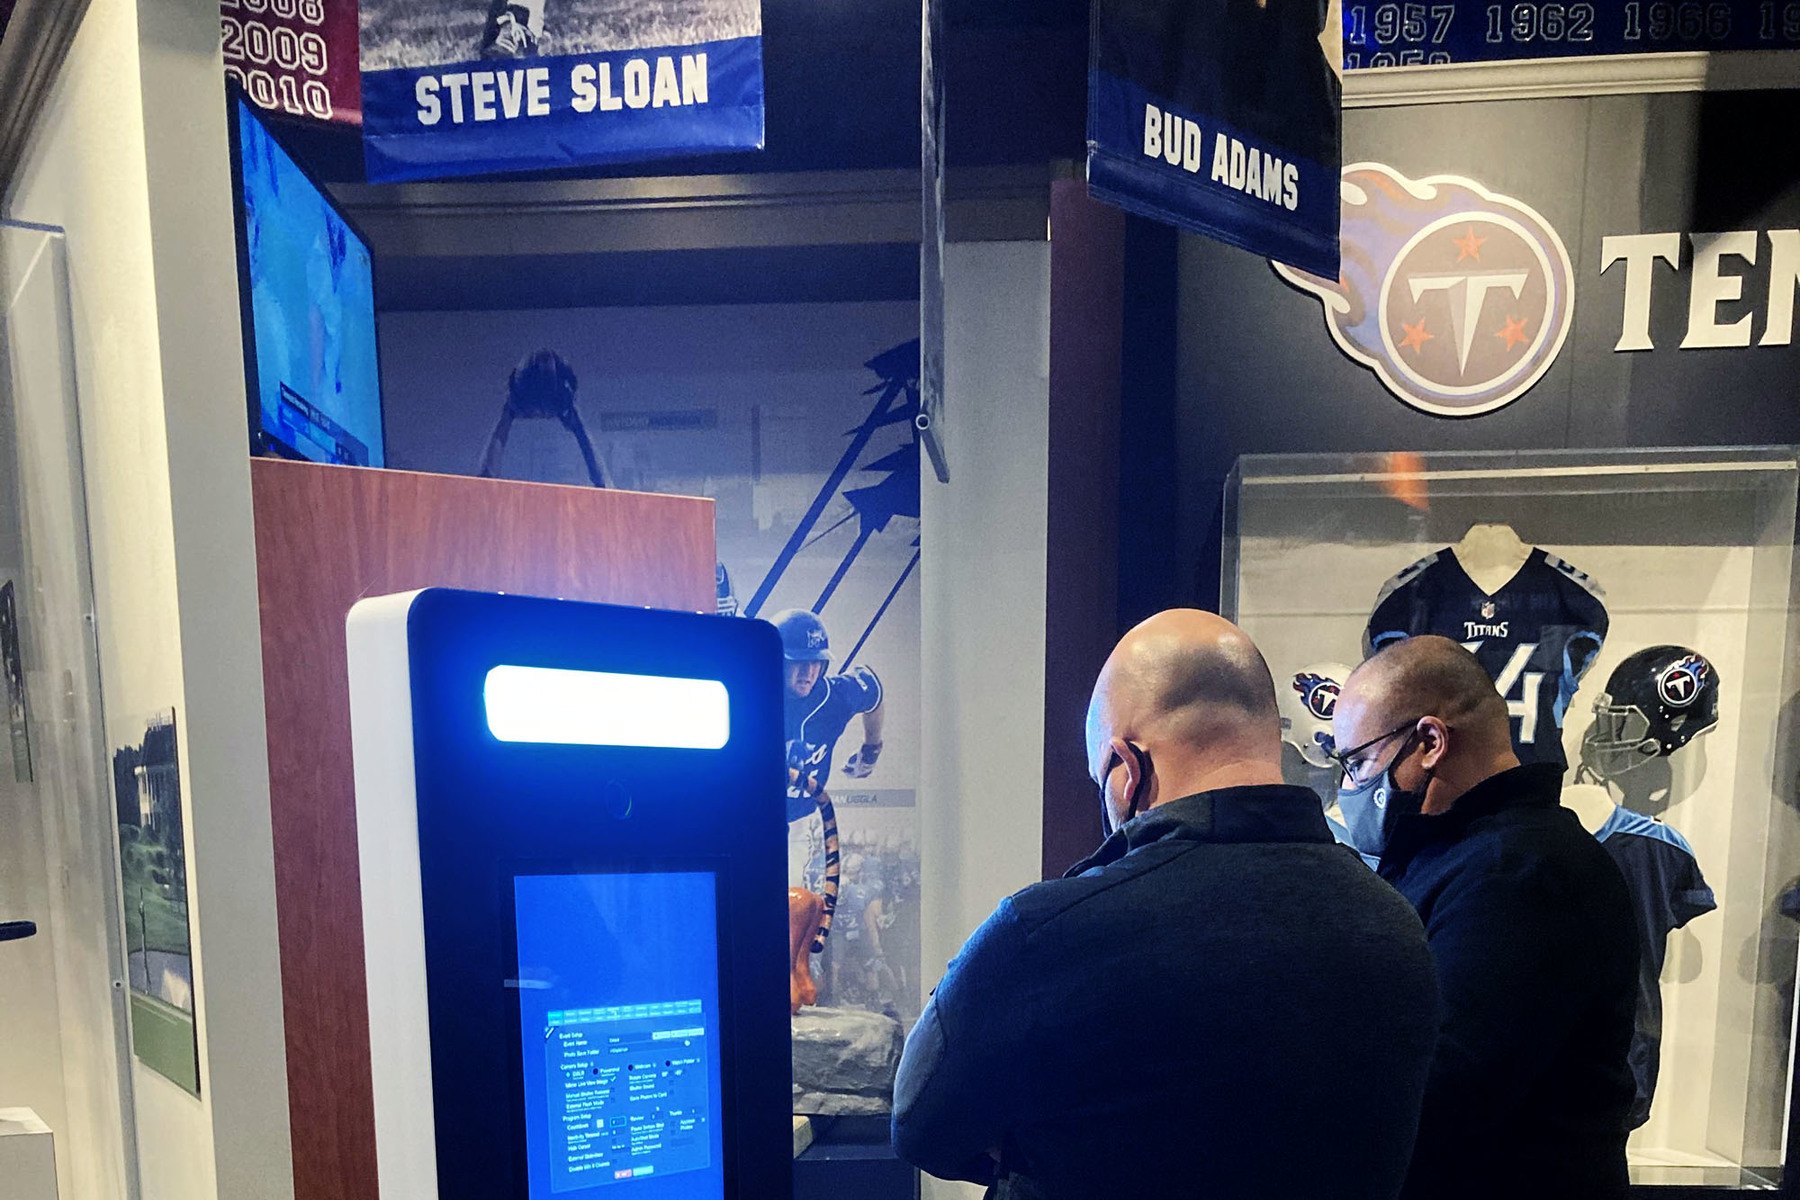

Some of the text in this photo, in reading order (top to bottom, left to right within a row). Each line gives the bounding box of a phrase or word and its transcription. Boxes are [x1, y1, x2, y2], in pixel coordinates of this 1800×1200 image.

[220, 15, 328, 76] 2009
[1350, 3, 1455, 44] 1957
[1486, 3, 1594, 43] 1962
[415, 53, 708, 126] STEVE SLOAN
[1144, 103, 1298, 211] BUD ADAMS
[1464, 621, 1509, 639] TITANS
